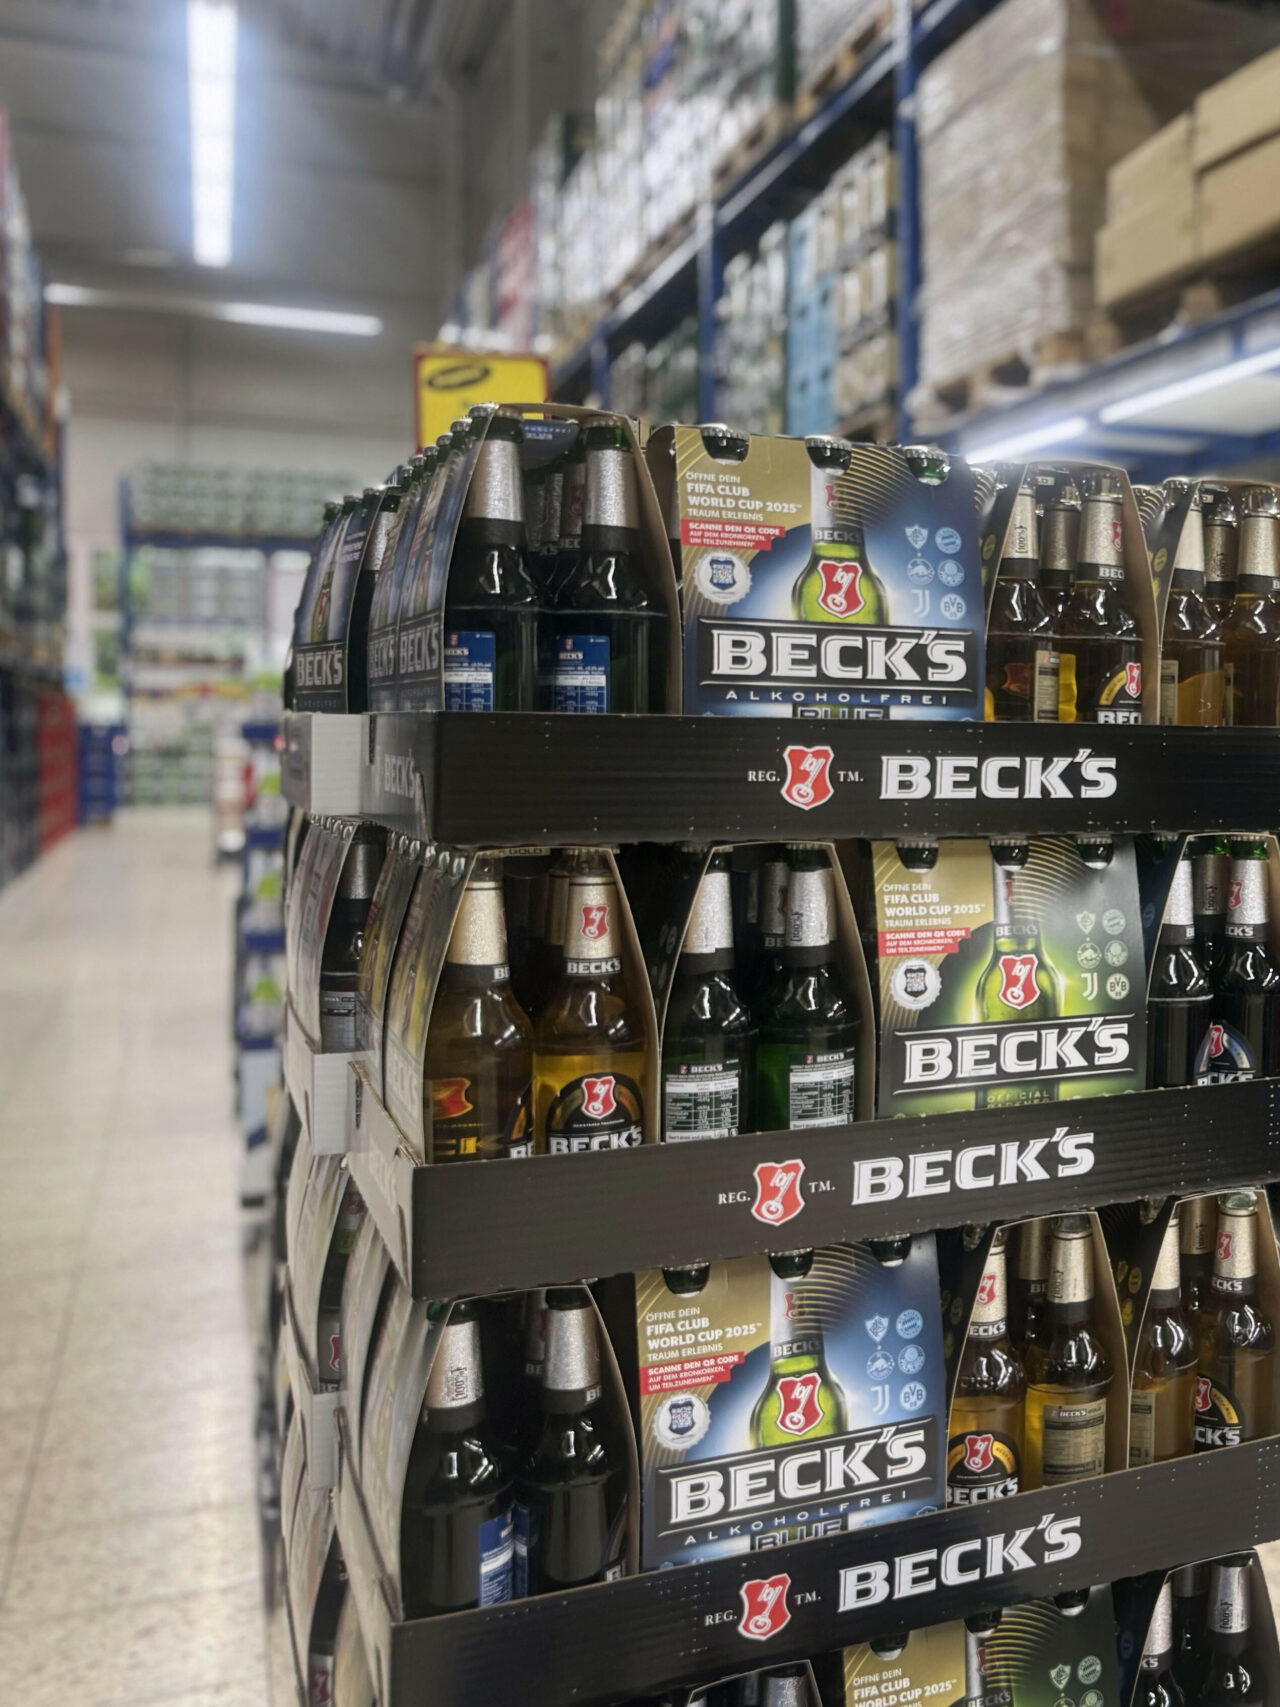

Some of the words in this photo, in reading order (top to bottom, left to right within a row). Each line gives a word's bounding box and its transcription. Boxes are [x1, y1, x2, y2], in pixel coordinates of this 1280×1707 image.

[686, 471, 715, 482] ÖFFNE
[719, 474, 740, 483] DEIN
[687, 483, 715, 494] FIFA
[717, 485, 749, 496] CLUB
[688, 496, 735, 508] WORLD
[738, 500, 763, 510] CUP
[688, 508, 720, 518] TRAUM
[722, 511, 763, 521] ERLEBNIS
[689, 522, 722, 531] SCANNE
[400, 614, 439, 674] BECK'S
[711, 630, 967, 682] BECK'S
[296, 645, 343, 686] BECK'S
[726, 690, 946, 704] ALKOHOLFREI
[748, 771, 780, 782] REG.
[838, 771, 864, 782] TM.
[880, 749, 1118, 799] BECK'S
[883, 883, 909, 892] ÖFFNE
[884, 895, 908, 904] FIFA
[911, 893, 939, 902] CLUB
[885, 907, 927, 916] WORLD
[930, 906, 952, 915] CUP
[915, 918, 951, 926] ERLEBNIS
[567, 958, 620, 974] BECK'S
[817, 1052, 844, 1062] BECK'S
[903, 1016, 1130, 1084] BECK'S
[691, 1064, 723, 1072] BECK'S
[987, 1090, 1049, 1103] OFFCIAL
[550, 1125, 643, 1155] BECK'S
[718, 1191, 751, 1205] REG.
[809, 1181, 835, 1193] TM.
[851, 1127, 1095, 1205] BECK'S
[646, 1312, 676, 1322] ÖFFNE
[679, 1307, 700, 1318] DEIN
[647, 1324, 674, 1336] FIFA
[677, 1317, 709, 1331] CLUB
[648, 1334, 695, 1349] WORLD
[698, 1328, 722, 1342] CUP
[648, 1350, 679, 1362] TRAUM
[682, 1343, 723, 1356] ERLEBNIS
[648, 1364, 681, 1375] SCANNE
[684, 1361, 701, 1370] DEN
[717, 1355, 739, 1364] CODE
[669, 1426, 926, 1524] BECK'S
[685, 1490, 906, 1544] ALKOHOLFREI
[704, 1609, 737, 1627] REG.
[794, 1590, 821, 1605] TM.
[837, 1513, 1082, 1613] BECK'S
[853, 1673, 879, 1686] ÖFFNE
[883, 1668, 901, 1678] DEIN
[854, 1685, 879, 1700] FIFA
[881, 1678, 910, 1693] CLUB
[855, 1694, 897, 1707] WORLD
[900, 1689, 922, 1702] CUP
